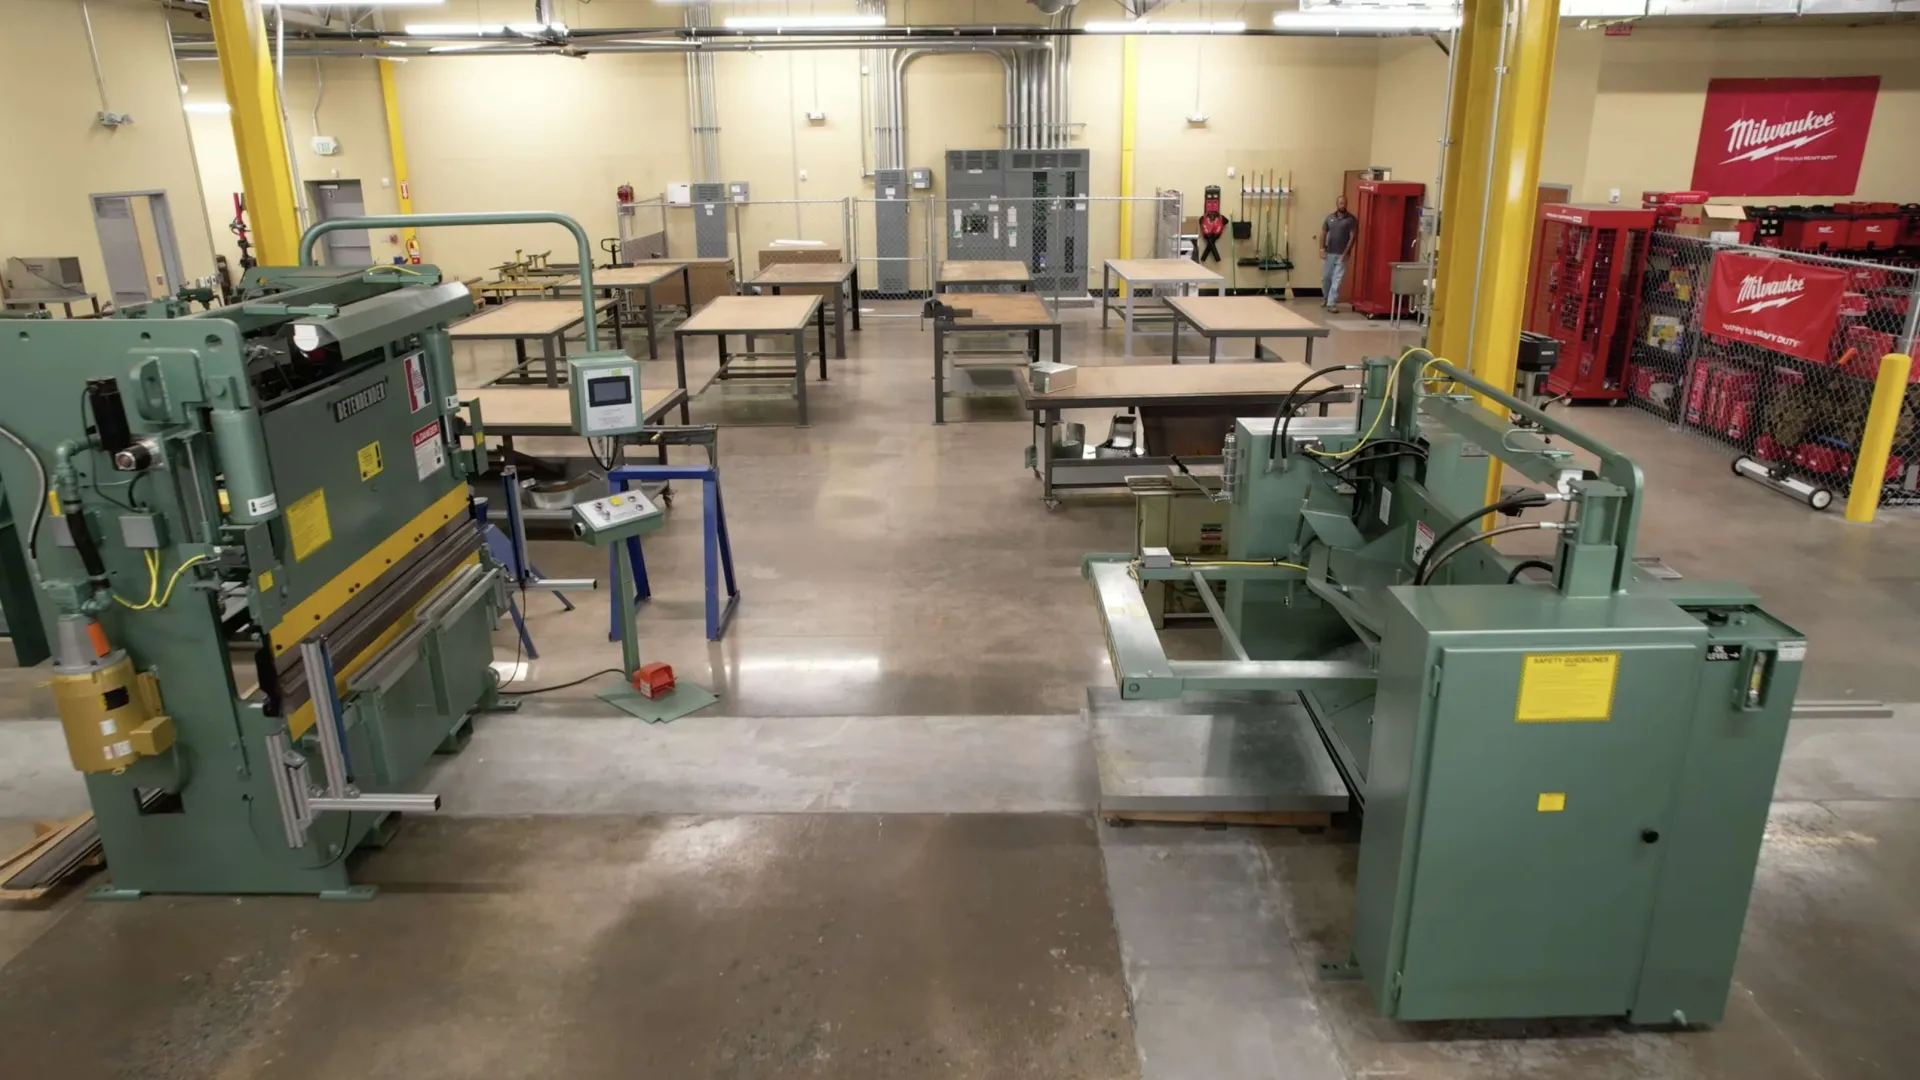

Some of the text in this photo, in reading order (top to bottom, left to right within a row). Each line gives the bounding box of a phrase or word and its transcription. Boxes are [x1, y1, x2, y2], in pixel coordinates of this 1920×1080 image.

[1724, 110, 1835, 153] Milwaukee
[1736, 273, 1805, 304] Milwaukee
[336, 382, 386, 421] BETENBENDER
[419, 424, 438, 442] DANGER
